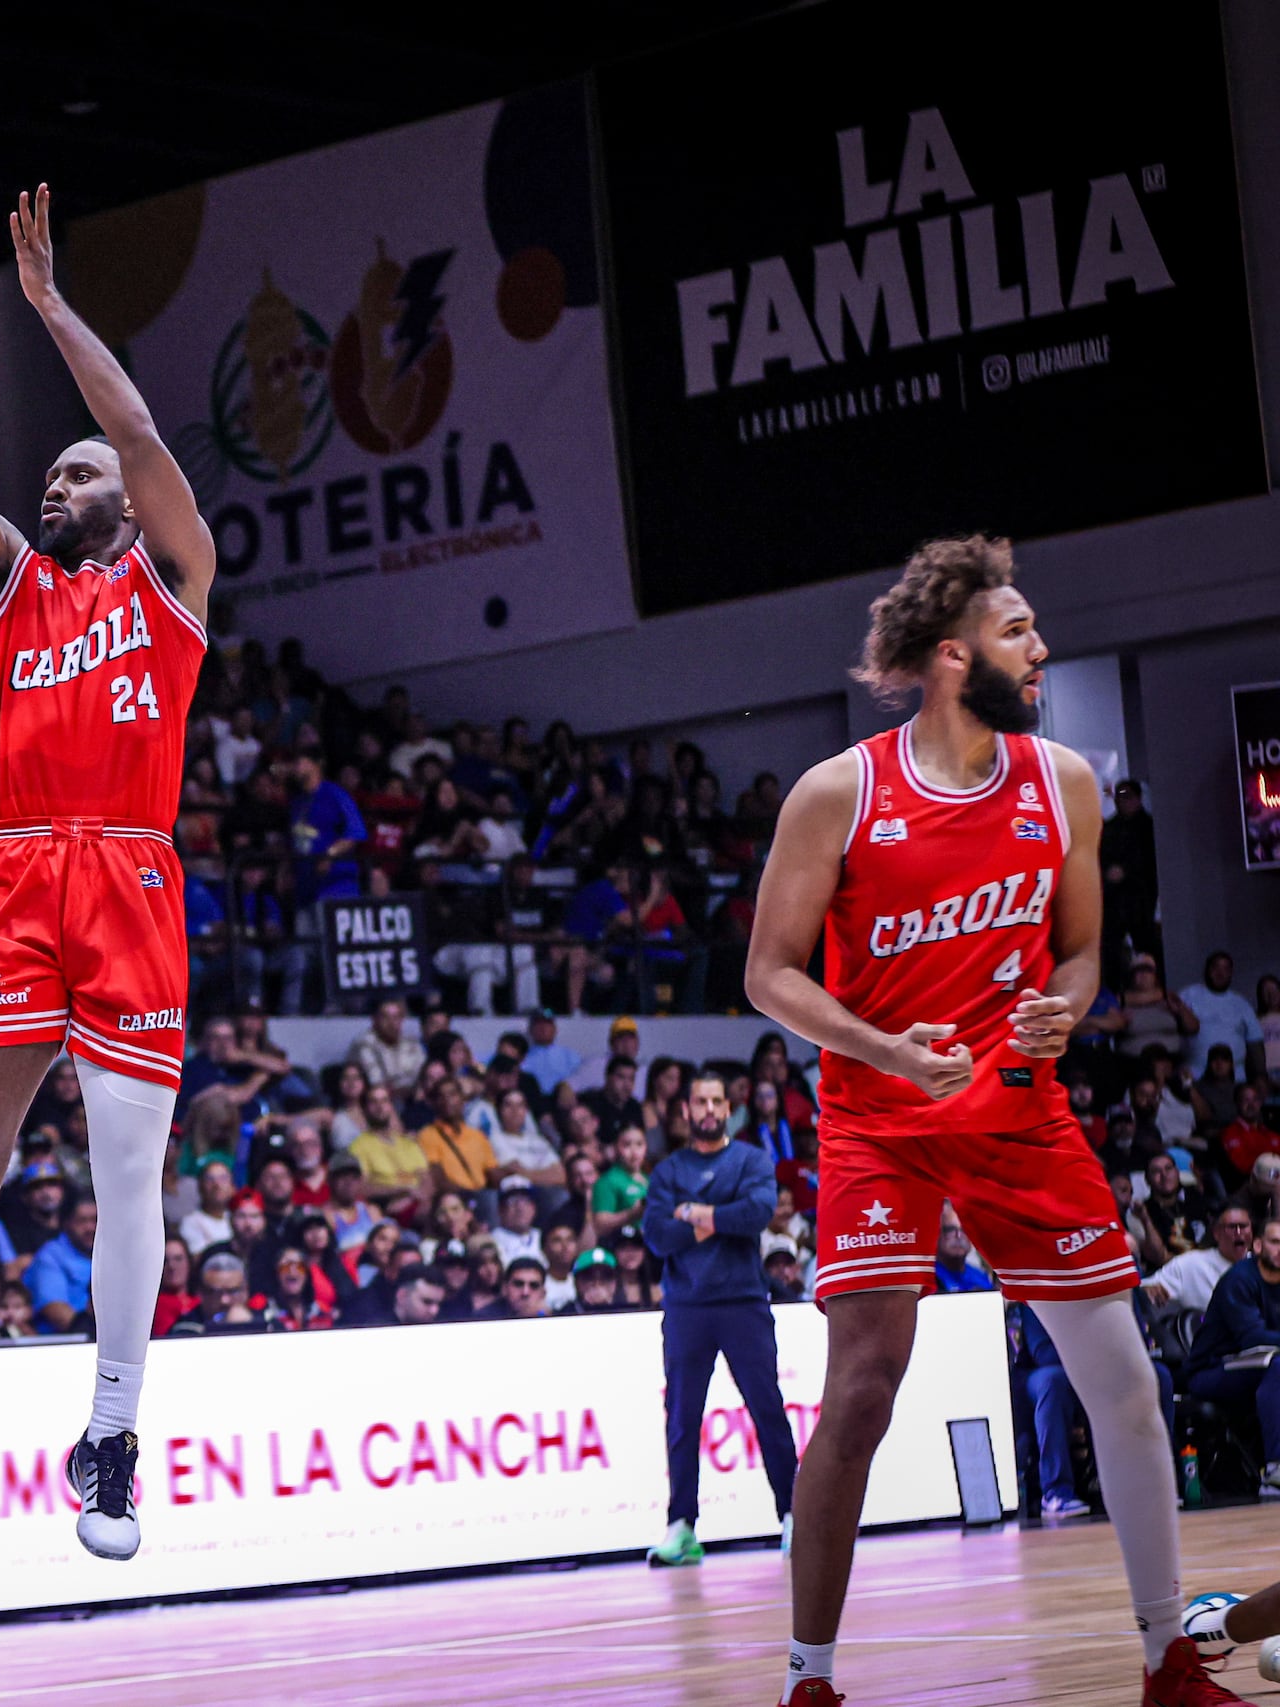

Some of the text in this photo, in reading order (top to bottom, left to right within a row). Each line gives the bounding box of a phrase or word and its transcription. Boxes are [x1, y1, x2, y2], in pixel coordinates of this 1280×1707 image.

[834, 103, 979, 230] LA
[674, 169, 1179, 401] FAMILIA
[213, 430, 536, 577] OTERÍA
[9, 591, 153, 691] CAROLA
[110, 672, 161, 724] 24
[335, 905, 412, 946] PALCO
[869, 868, 1055, 958] CAROLA
[337, 948, 420, 990] ESTE 5
[992, 949, 1024, 992] 4
[118, 1007, 183, 1033] CAROLA
[835, 1229, 916, 1251] Heineken
[166, 1433, 246, 1507] EN
[268, 1427, 342, 1499] LA
[359, 1407, 611, 1490] CANCHA
